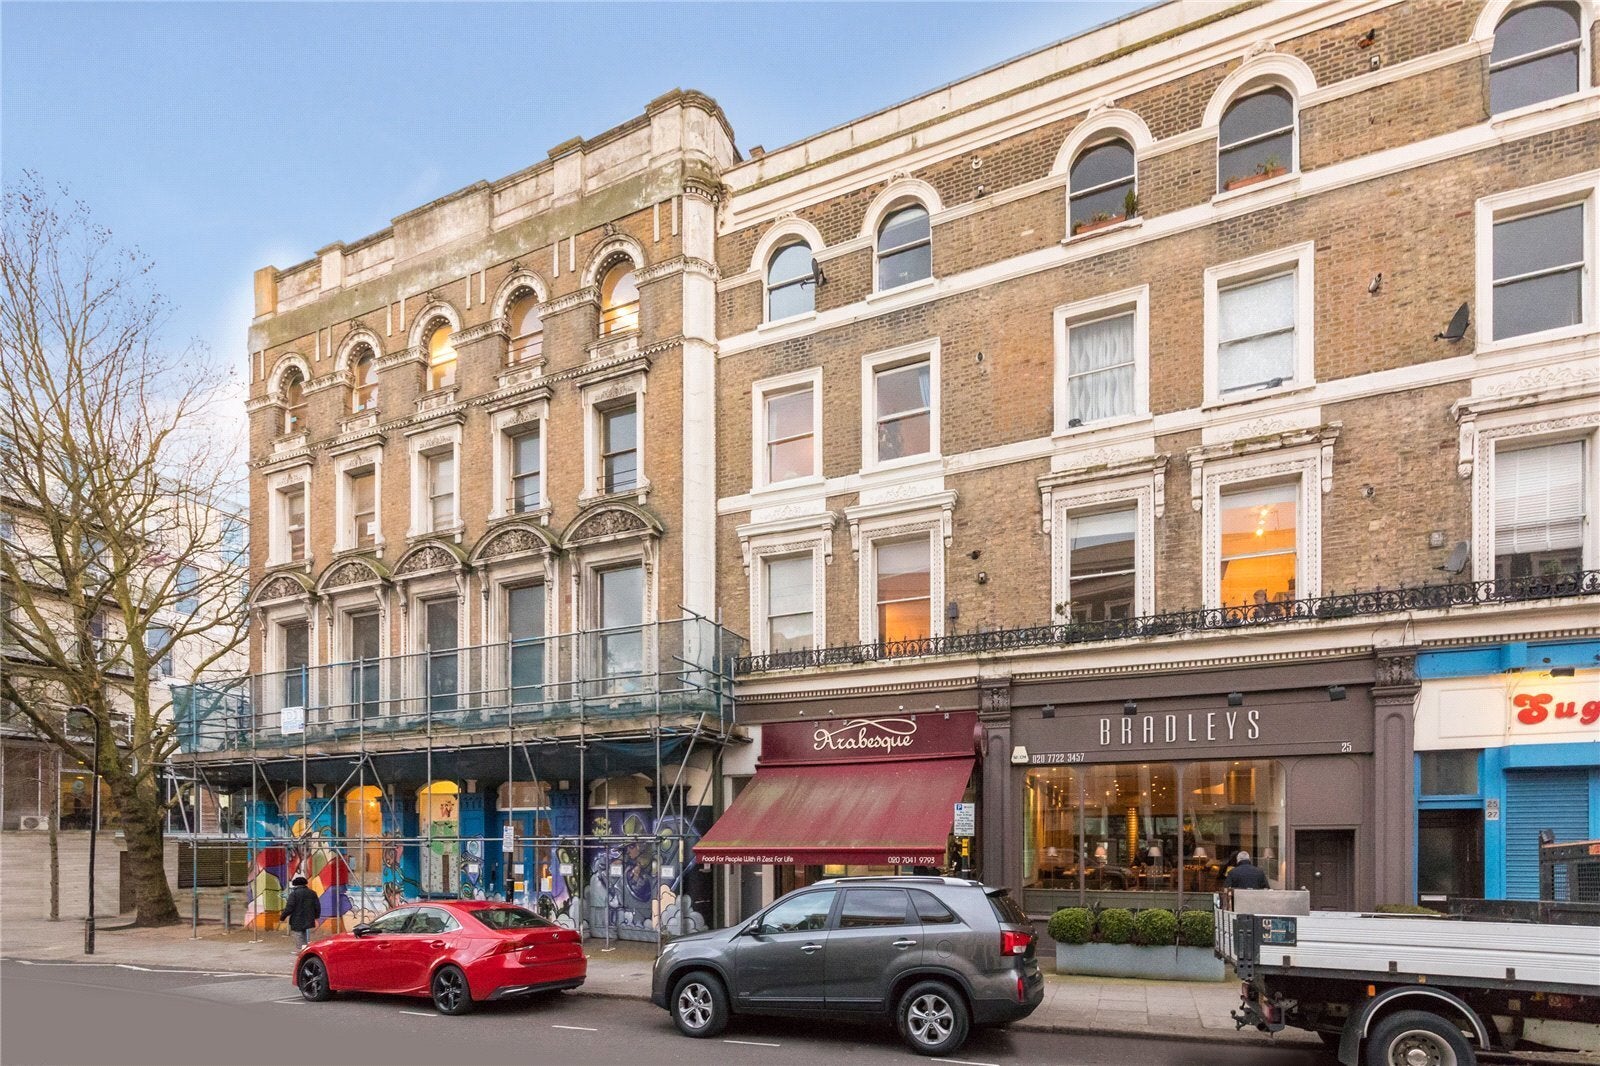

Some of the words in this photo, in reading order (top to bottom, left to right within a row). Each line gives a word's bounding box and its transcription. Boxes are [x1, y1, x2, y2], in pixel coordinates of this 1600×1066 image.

[1100, 710, 1260, 745] BRADLEYS
[813, 718, 917, 754] Arabesque
[1341, 742, 1352, 752] 25
[1032, 754, 1045, 764] 020
[1047, 753, 1065, 763] 7722
[1067, 752, 1085, 762] 3457
[725, 855, 742, 863] People
[887, 856, 900, 864] 020
[901, 856, 917, 864] 7041
[918, 856, 936, 864] 9793
